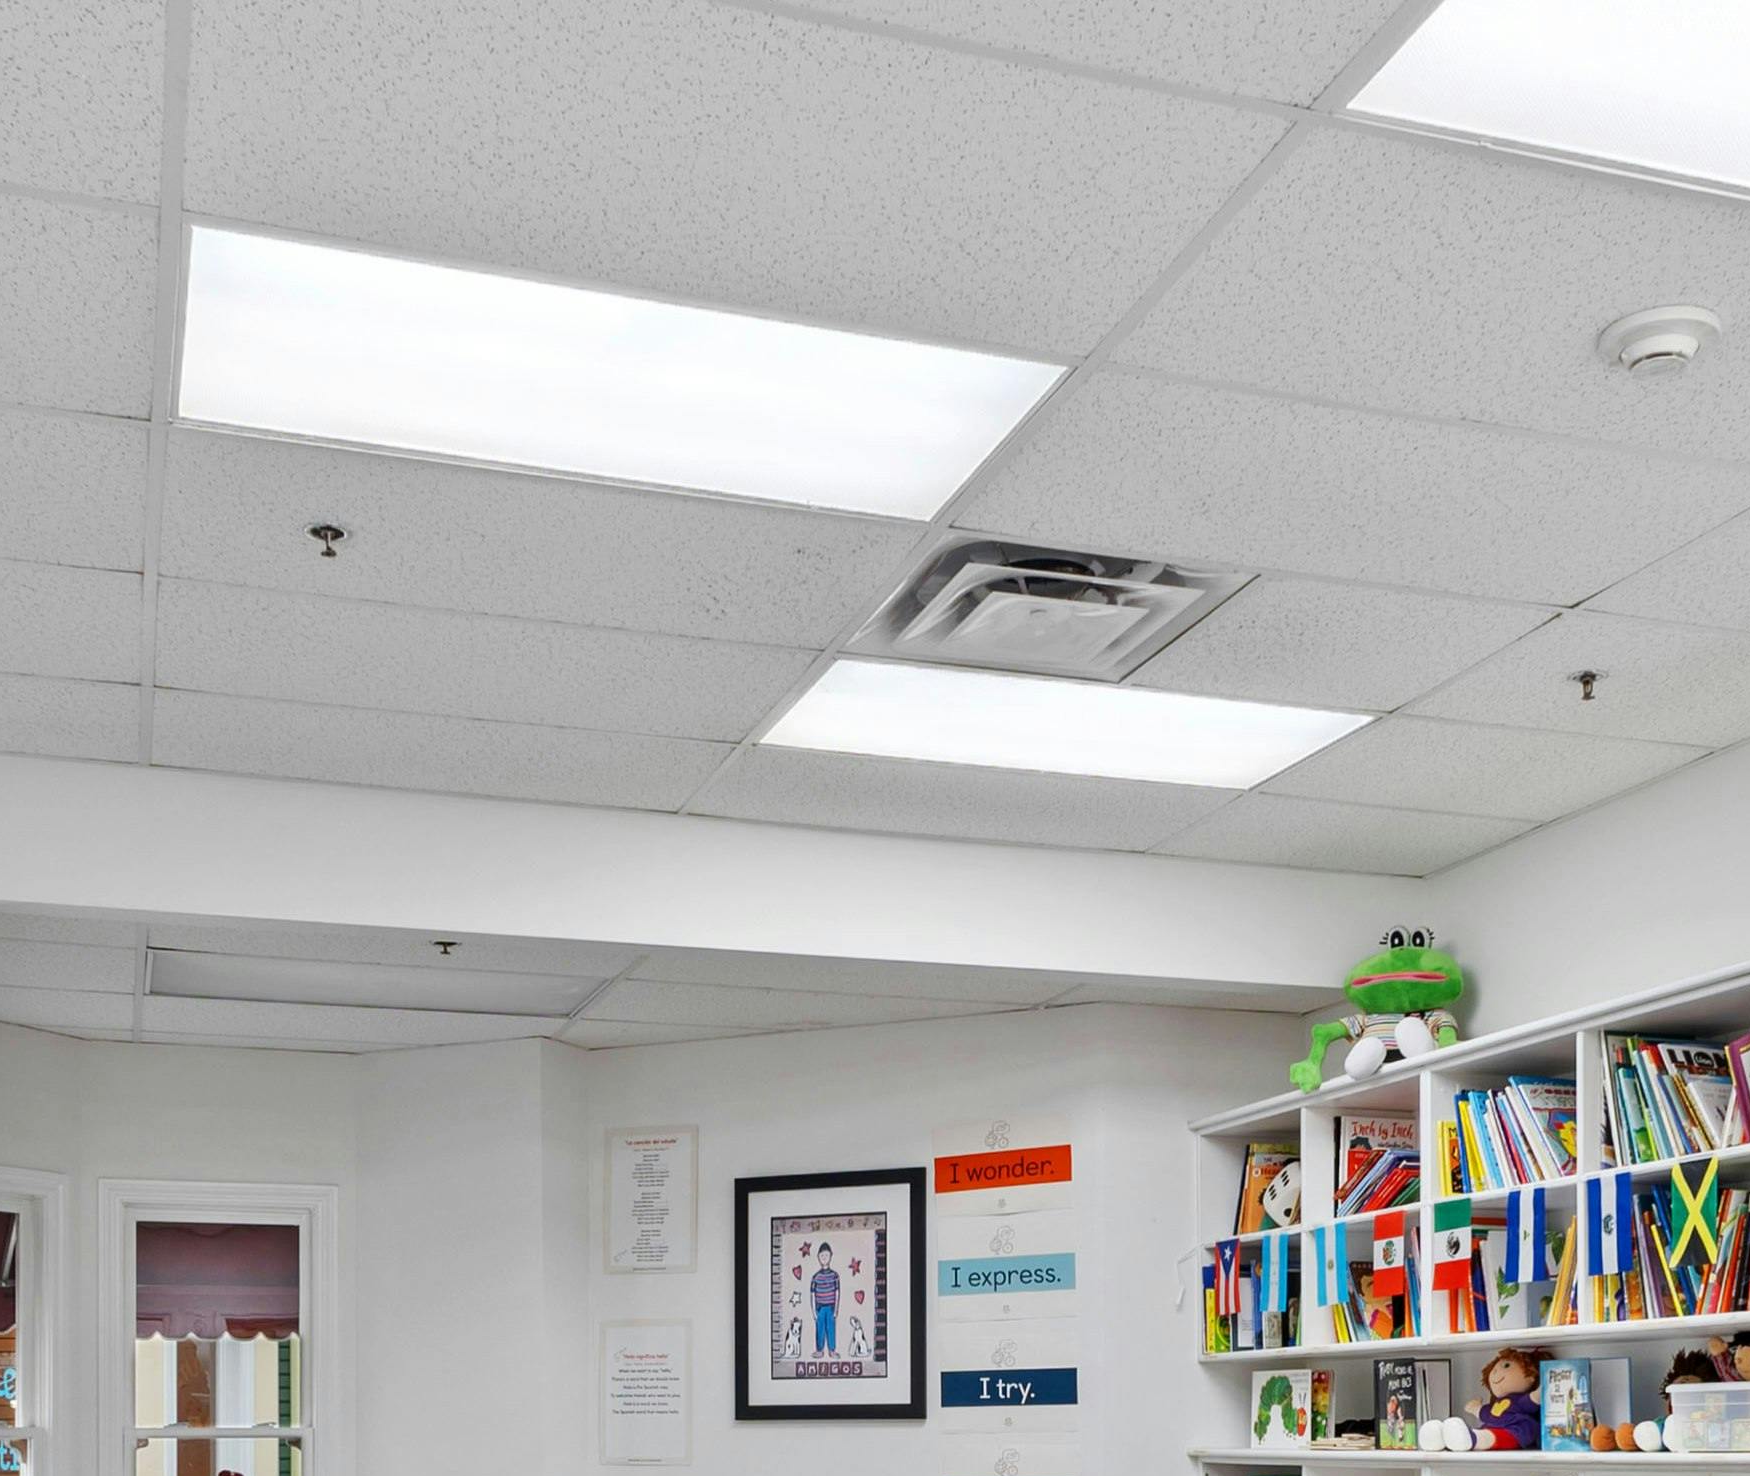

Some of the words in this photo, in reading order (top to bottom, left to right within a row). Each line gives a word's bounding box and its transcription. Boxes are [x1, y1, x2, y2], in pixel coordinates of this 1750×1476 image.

[950, 1163, 959, 1184] I
[966, 1156, 1055, 1182] wonder.
[951, 1267, 961, 1288] I
[968, 1267, 1061, 1292] express.
[797, 1363, 860, 1374] AMIGOS
[979, 1377, 991, 1399] I
[996, 1378, 1035, 1404] try.
